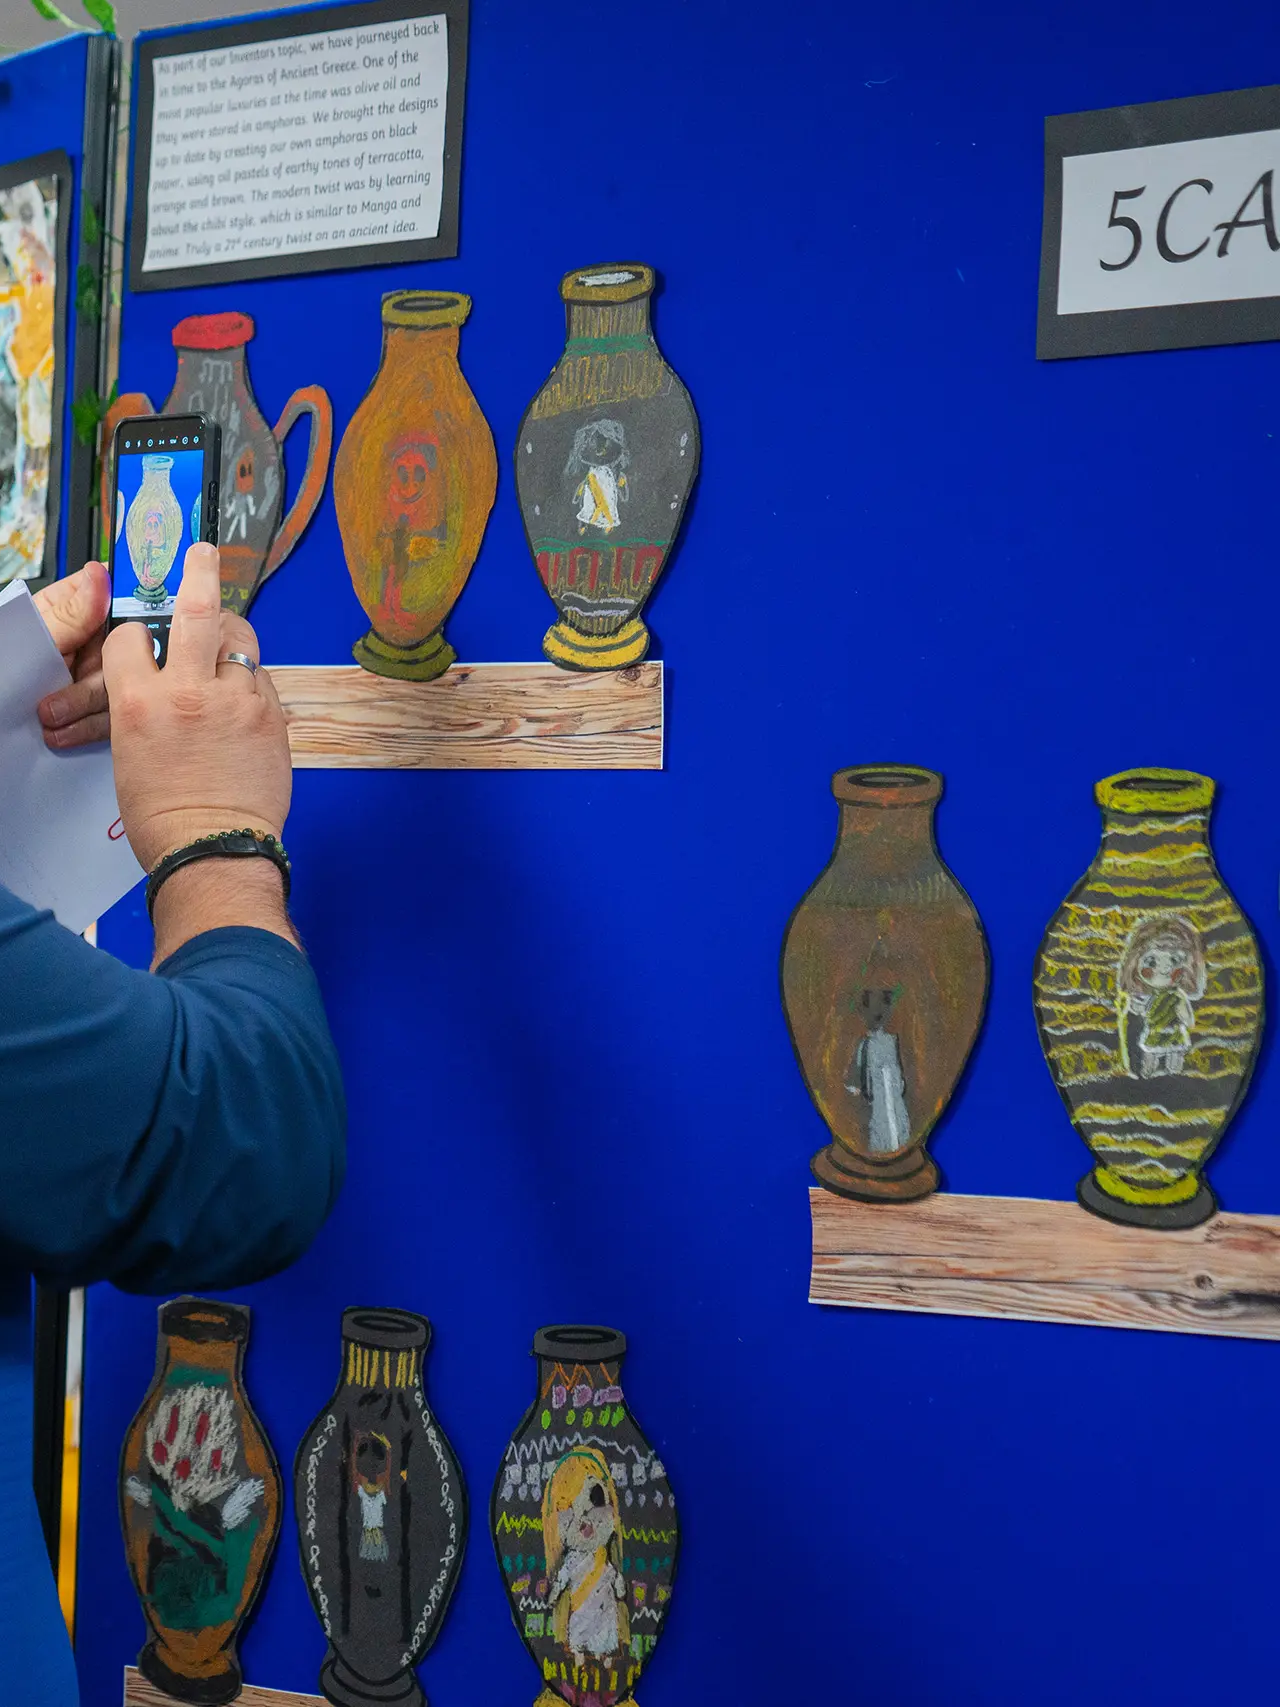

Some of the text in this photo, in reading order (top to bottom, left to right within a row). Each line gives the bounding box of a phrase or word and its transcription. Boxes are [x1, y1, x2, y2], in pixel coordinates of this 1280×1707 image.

[159, 20, 440, 75] As part of our Inventors topic, we have journeyed back
[158, 72, 421, 120] most popular luxuries at the time was olive oil and
[160, 88, 168, 97] in
[171, 85, 194, 97] time
[196, 81, 208, 93] to
[210, 78, 227, 90] the
[229, 74, 264, 90] Agoras
[266, 68, 277, 86] of
[280, 64, 319, 80] Ancient
[362, 55, 384, 69] One
[387, 50, 399, 70] of
[401, 49, 419, 64] the
[155, 121, 418, 169] up to date by creating our own amphoras on black
[156, 97, 439, 146] they were stored in amphoras. We brought the designs
[187, 173, 215, 188] using
[217, 168, 231, 182] oil
[234, 165, 270, 183] pastels
[272, 162, 283, 179] of
[285, 160, 320, 175] earthy
[322, 158, 351, 171] tones
[354, 151, 366, 170] of
[368, 148, 425, 165] terracotta,
[151, 223, 180, 237] about
[182, 220, 199, 234] the
[260, 208, 292, 224] which
[294, 208, 303, 221] is
[306, 205, 342, 220] similar
[347, 204, 358, 215] to
[361, 200, 397, 215] Manga
[401, 193, 422, 210] and
[152, 201, 187, 216] orange
[189, 196, 209, 209] and
[251, 189, 269, 202] The
[272, 184, 311, 199] modern
[314, 181, 340, 195] twist
[344, 179, 366, 192] was
[369, 175, 383, 192] by
[386, 170, 431, 187] learning
[186, 242, 212, 256] Truly
[214, 242, 222, 252] a
[243, 235, 283, 249] century
[286, 230, 313, 245] twist
[315, 231, 328, 242] on
[332, 229, 346, 239] an
[349, 223, 388, 237] ancient
[393, 219, 418, 234] idea.
[1099, 168, 1280, 271] 5CA
